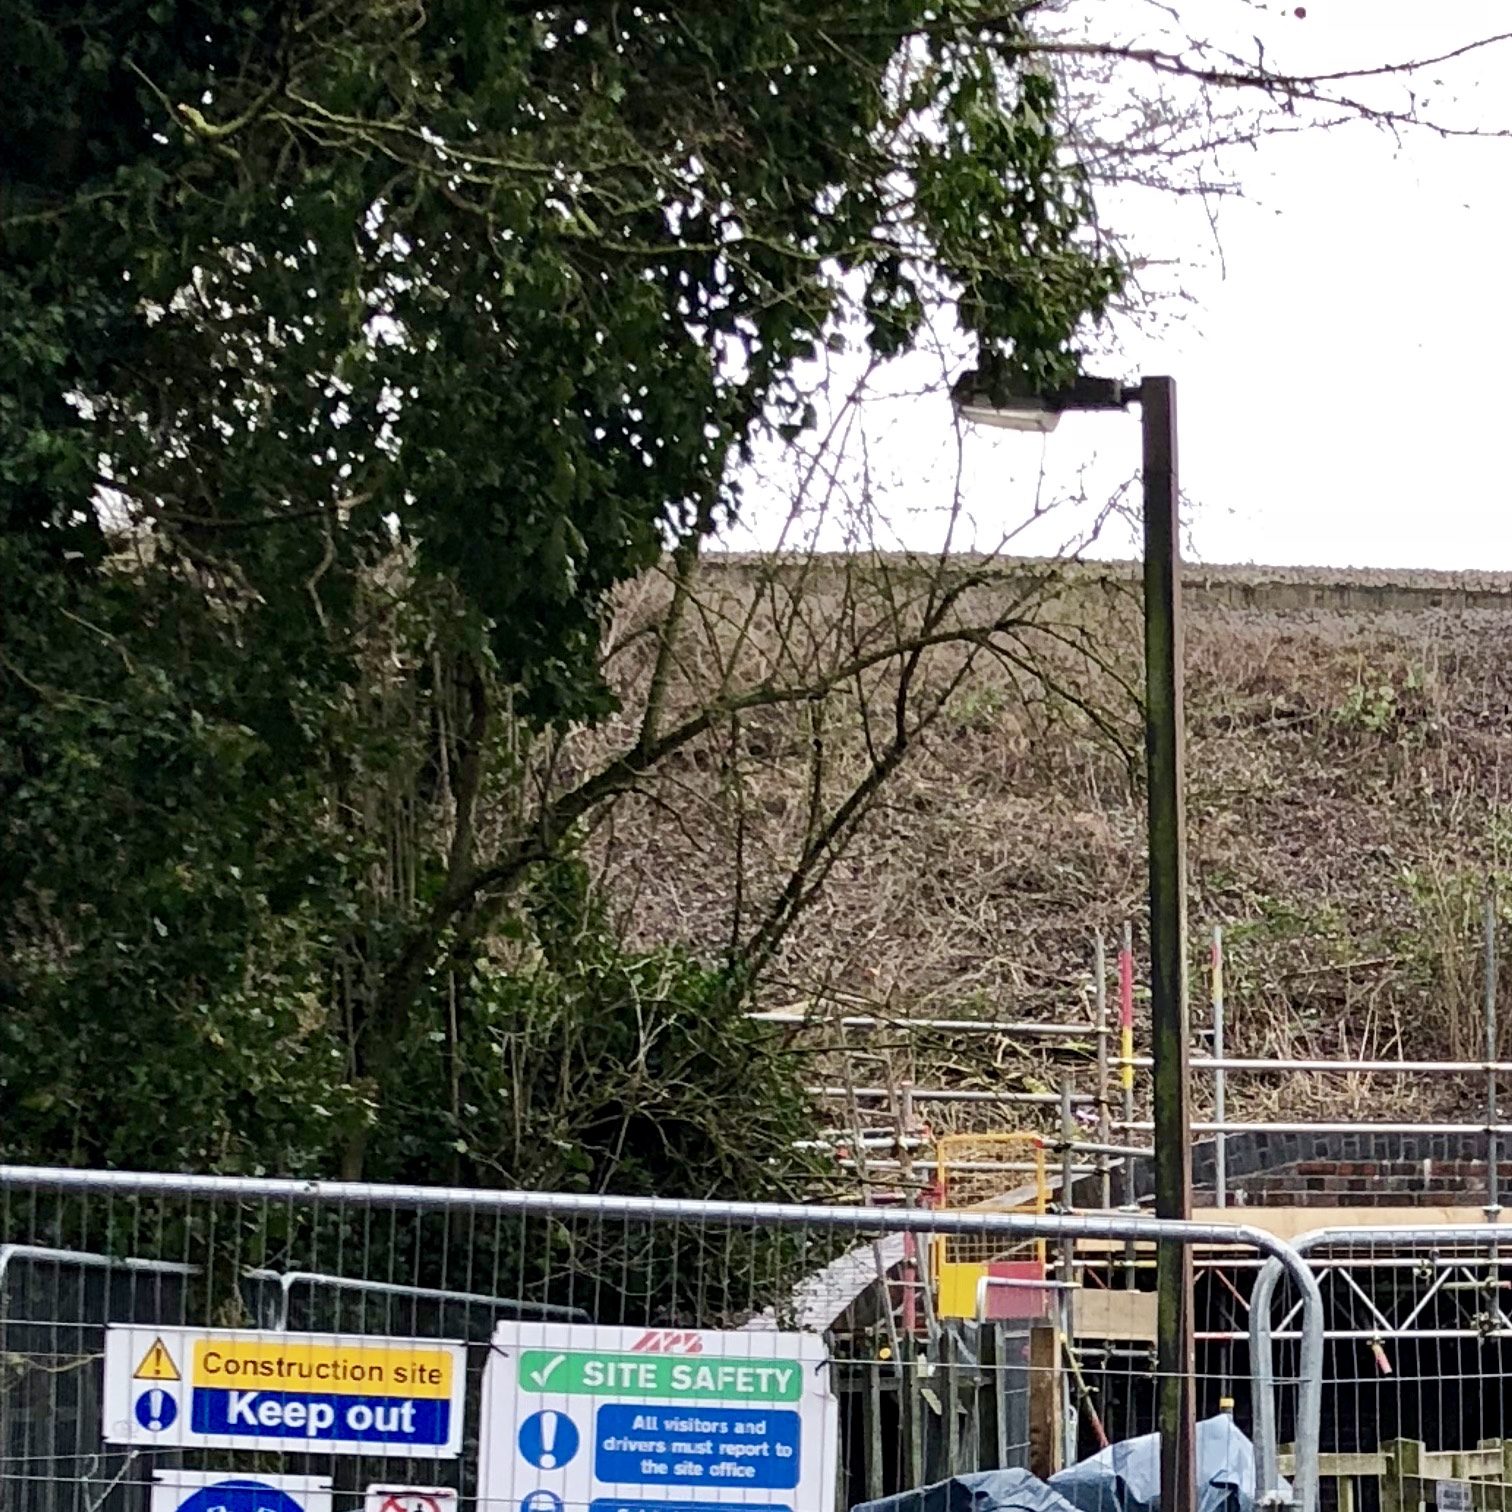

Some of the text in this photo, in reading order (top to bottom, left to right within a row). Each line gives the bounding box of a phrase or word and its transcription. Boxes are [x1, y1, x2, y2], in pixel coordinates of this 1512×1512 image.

[203, 1352, 442, 1385] Construction site
[583, 1360, 793, 1394] SITE SAFETY
[227, 1391, 416, 1437] Keep out
[632, 1415, 767, 1435] All visitors and
[603, 1437, 792, 1458] drivers must report to
[640, 1459, 756, 1478] the site office
